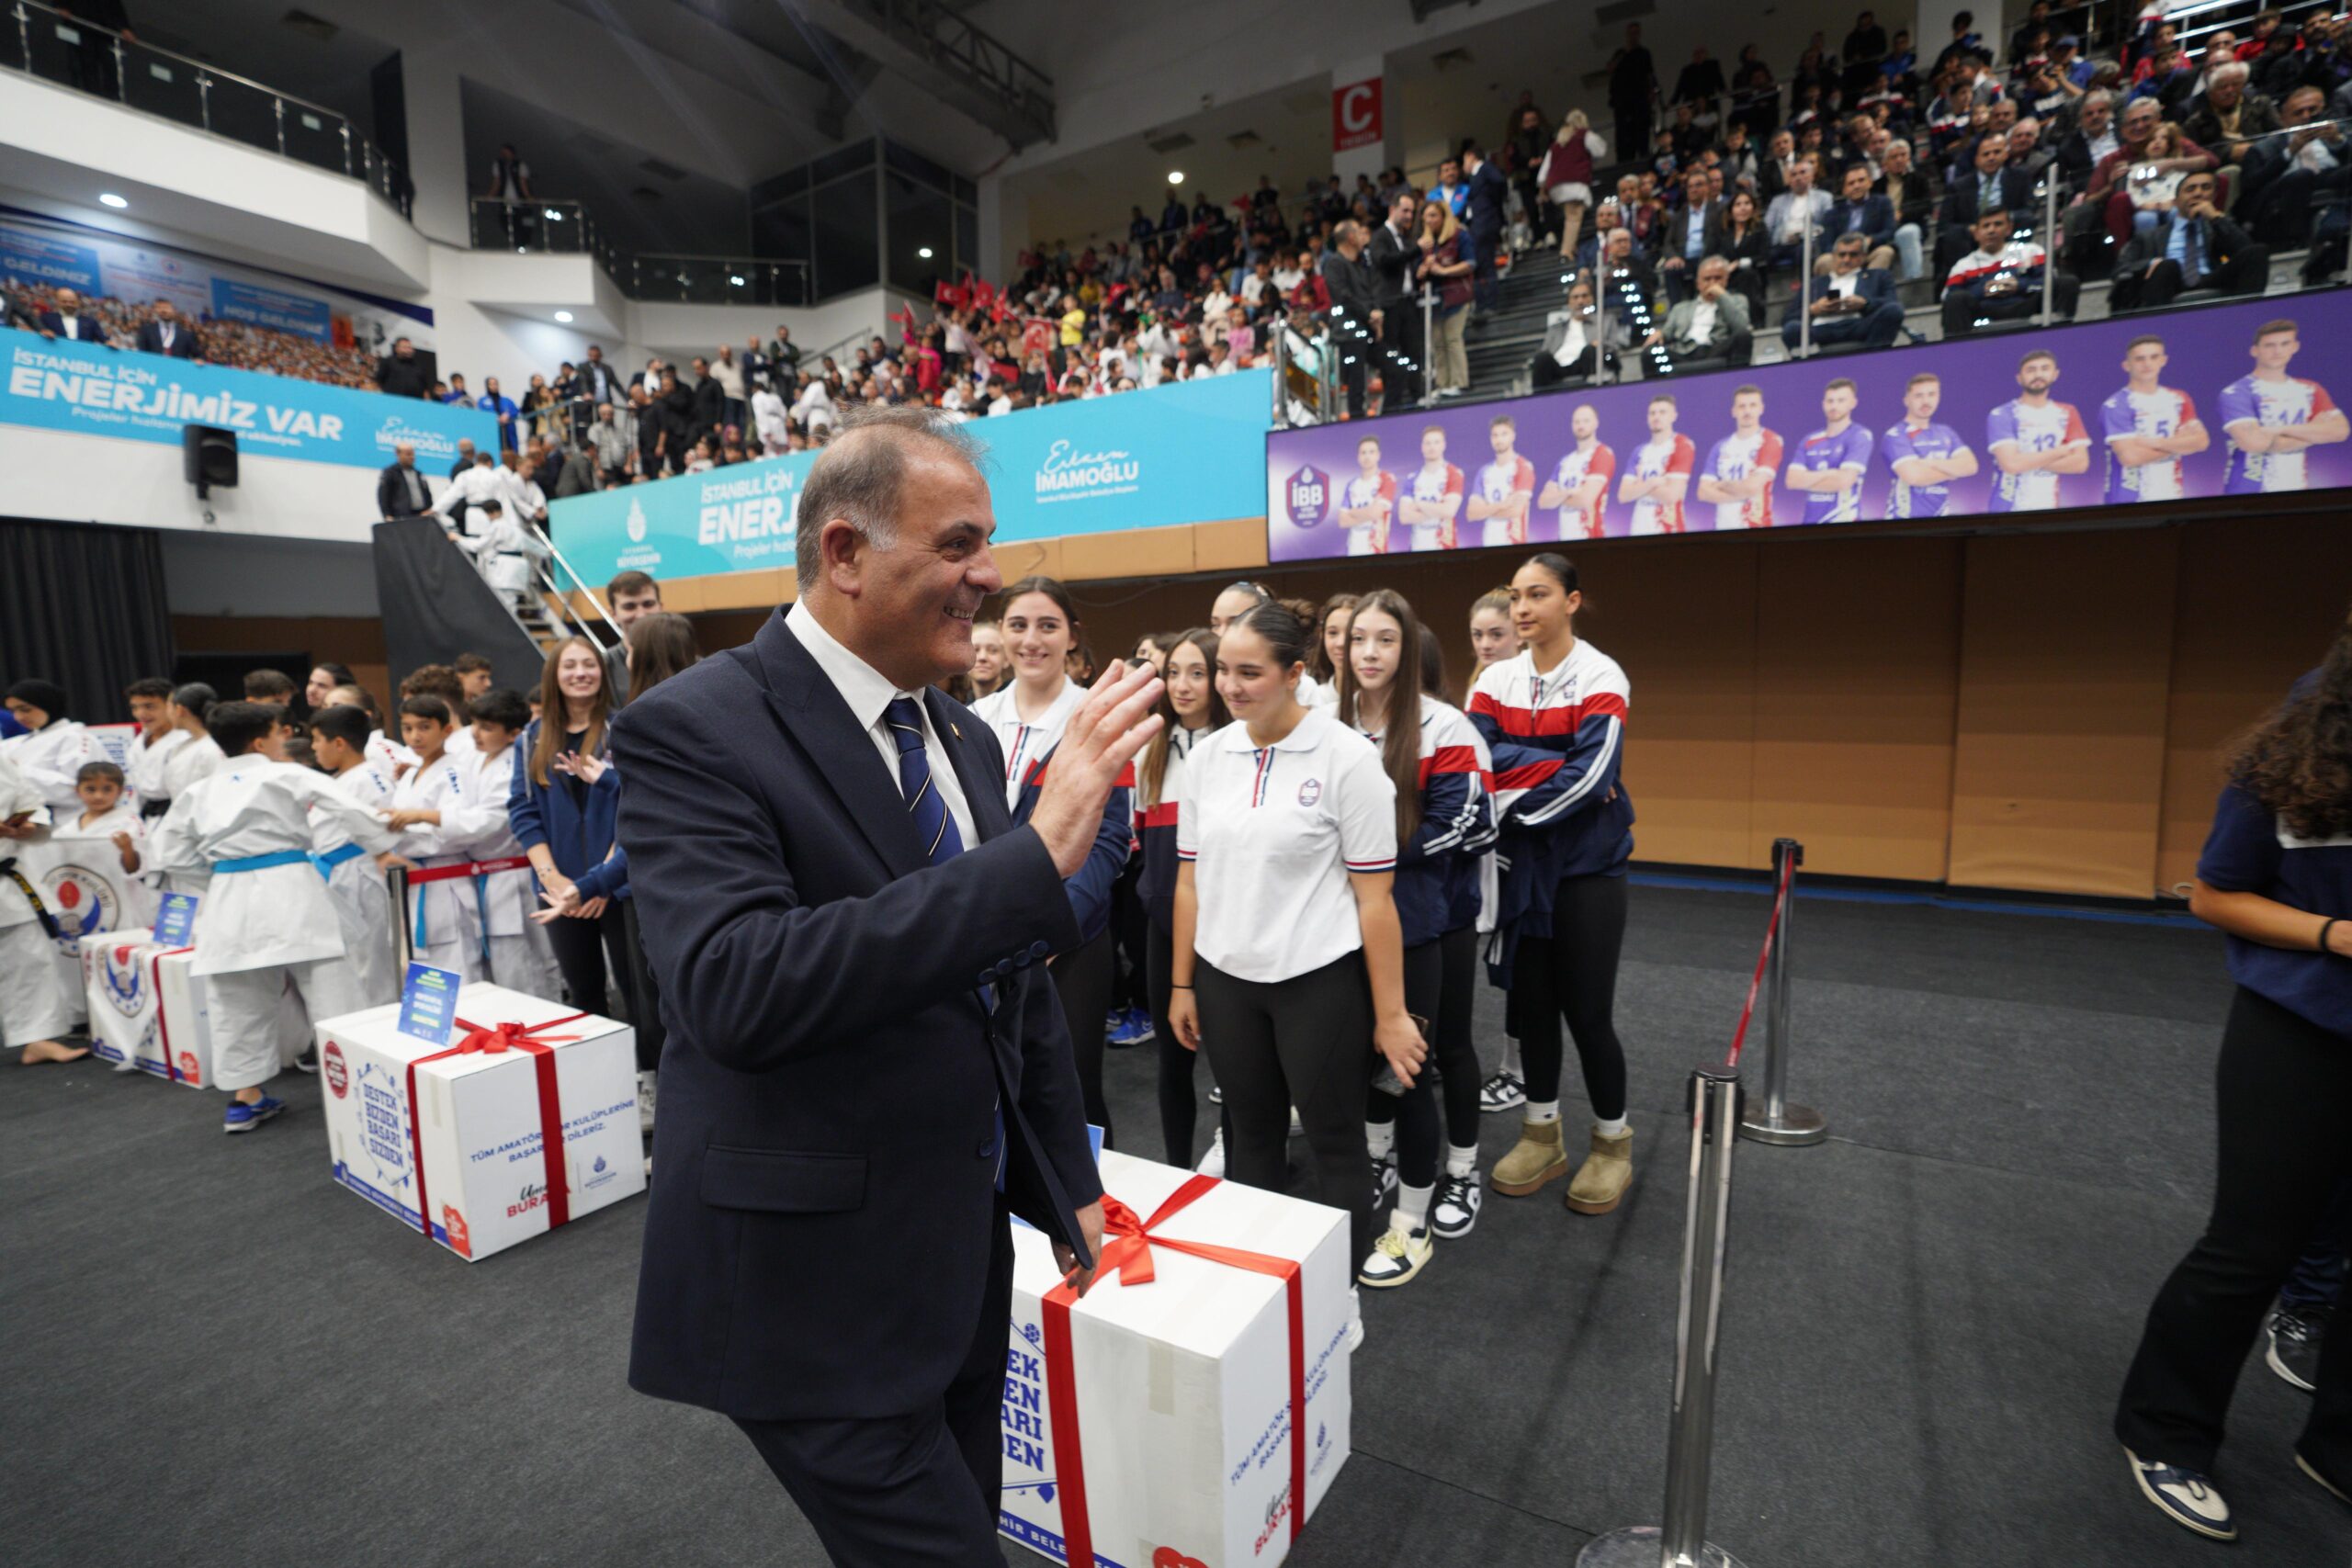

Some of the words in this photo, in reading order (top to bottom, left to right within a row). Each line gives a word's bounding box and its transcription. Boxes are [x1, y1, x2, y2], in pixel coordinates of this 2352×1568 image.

[1341, 85, 1374, 132] C
[13, 345, 115, 379] İSTANBUL
[117, 364, 158, 386] İÇİN
[9, 366, 257, 429] ENERJİMİZ
[265, 405, 344, 441] VAR
[2155, 420, 2169, 439] 5
[700, 476, 763, 504] İSTANBUL
[764, 468, 794, 495] İÇİN
[1035, 460, 1139, 493] İMAMOĞLU
[1727, 463, 1744, 481] 11
[1292, 481, 1324, 508] İBB
[698, 492, 801, 546] ENERJ
[363, 1082, 398, 1112] DESTEK
[470, 1148, 495, 1164] TÜM
[572, 1099, 635, 1127] KULÜPLERİNE
